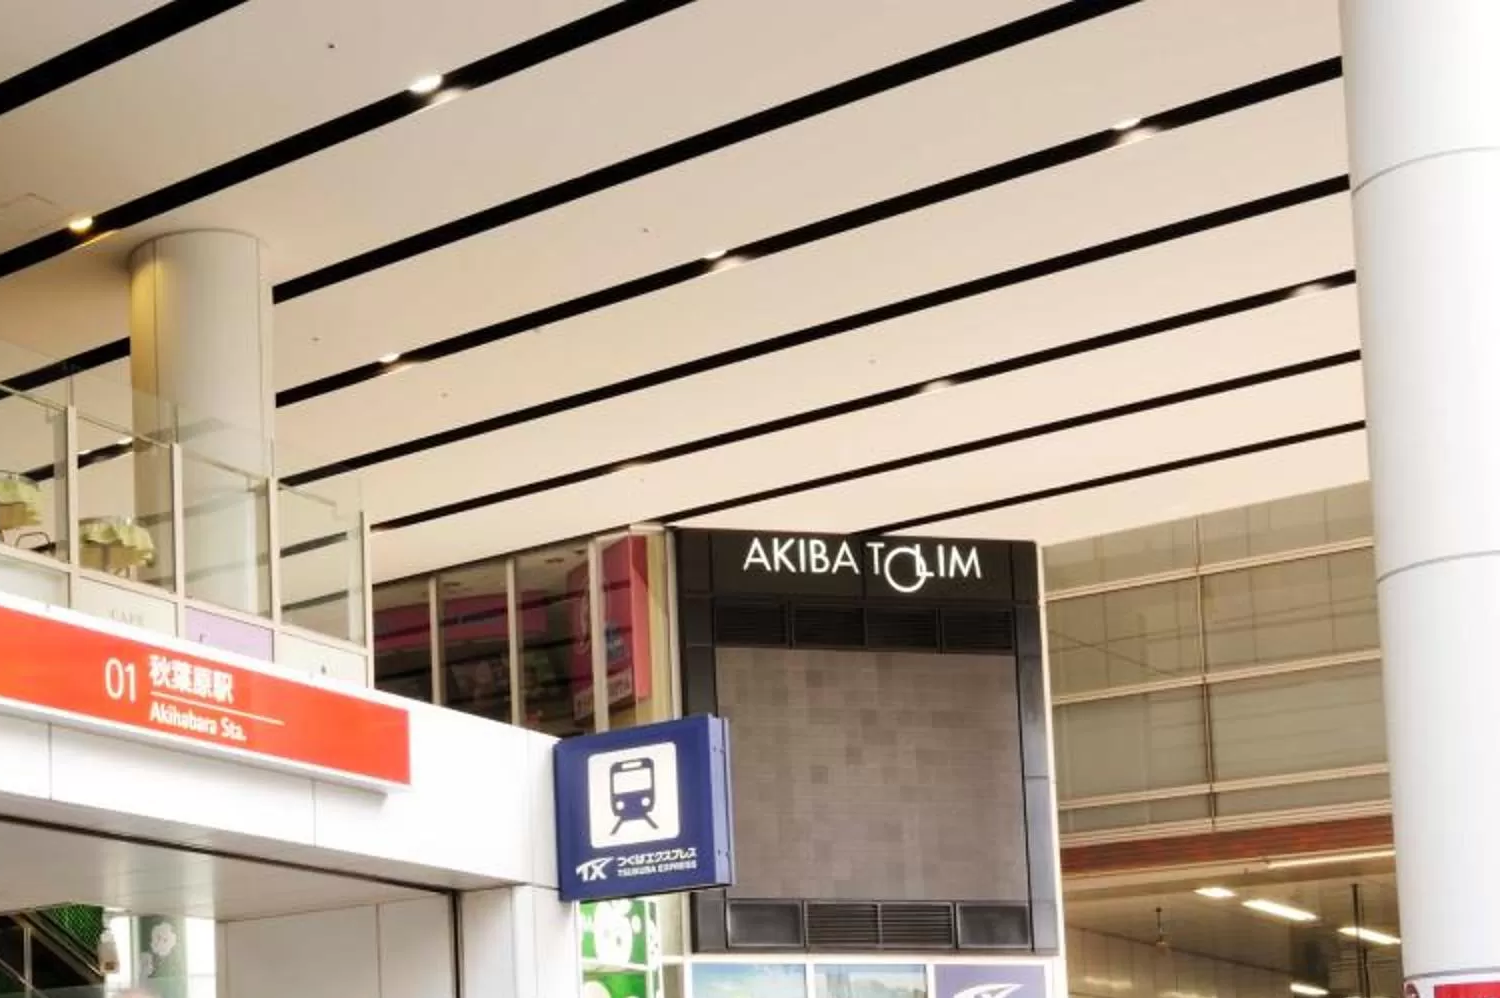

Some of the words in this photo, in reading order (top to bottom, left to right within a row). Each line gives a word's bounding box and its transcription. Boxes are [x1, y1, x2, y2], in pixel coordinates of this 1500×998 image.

[743, 537, 860, 575] AKIBA
[866, 541, 981, 593] TOLIM
[105, 657, 137, 702] 01
[149, 654, 234, 704] 秋葉原駅
[150, 701, 217, 736] Akihabara
[576, 856, 615, 882] TX
